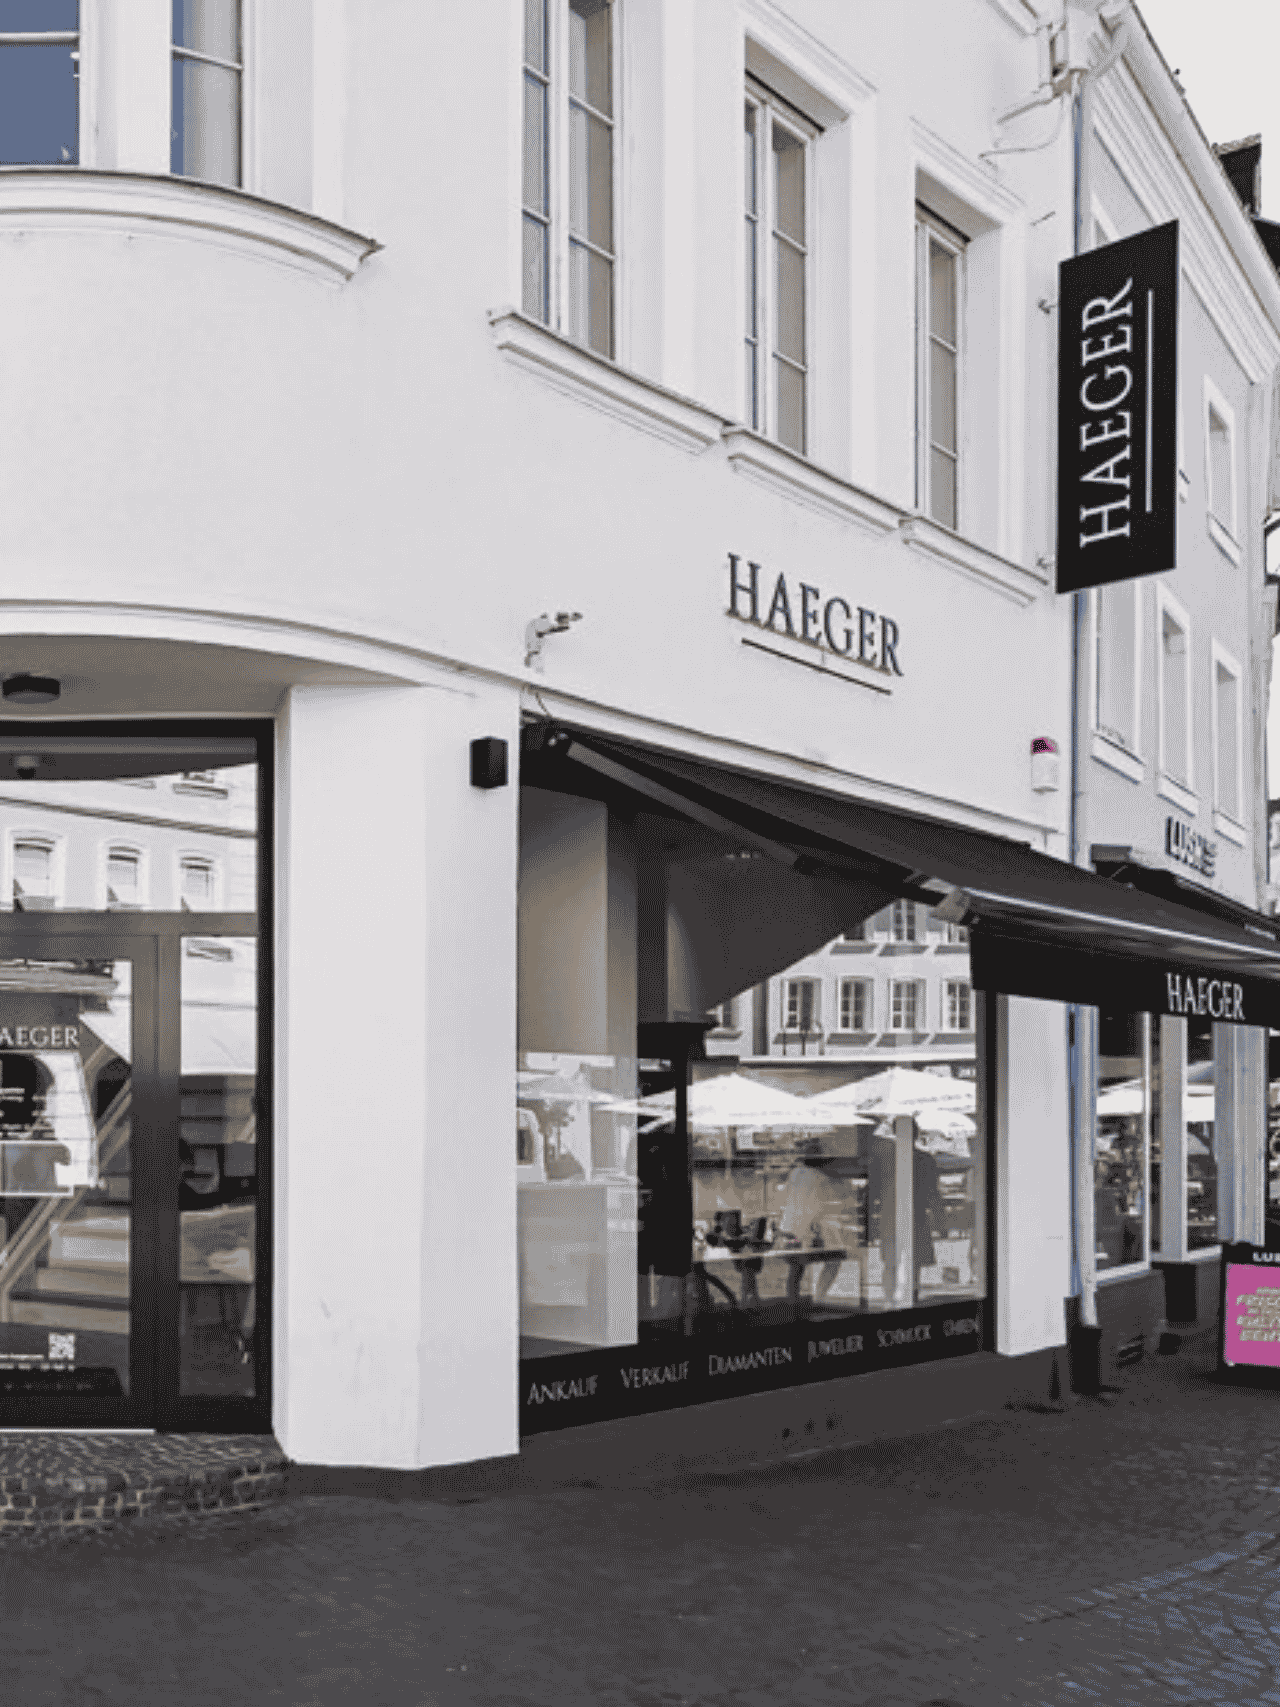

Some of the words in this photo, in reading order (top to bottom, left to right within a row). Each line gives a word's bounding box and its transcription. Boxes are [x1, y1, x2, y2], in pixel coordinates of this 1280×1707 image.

[1080, 277, 1133, 548] HAEGER
[726, 552, 904, 677] HAEGER
[1166, 972, 1246, 1021] HAEGER
[527, 1375, 598, 1406] ANKAUF
[620, 1361, 690, 1389] VERKAUF
[708, 1347, 793, 1376] DIAMANTEN
